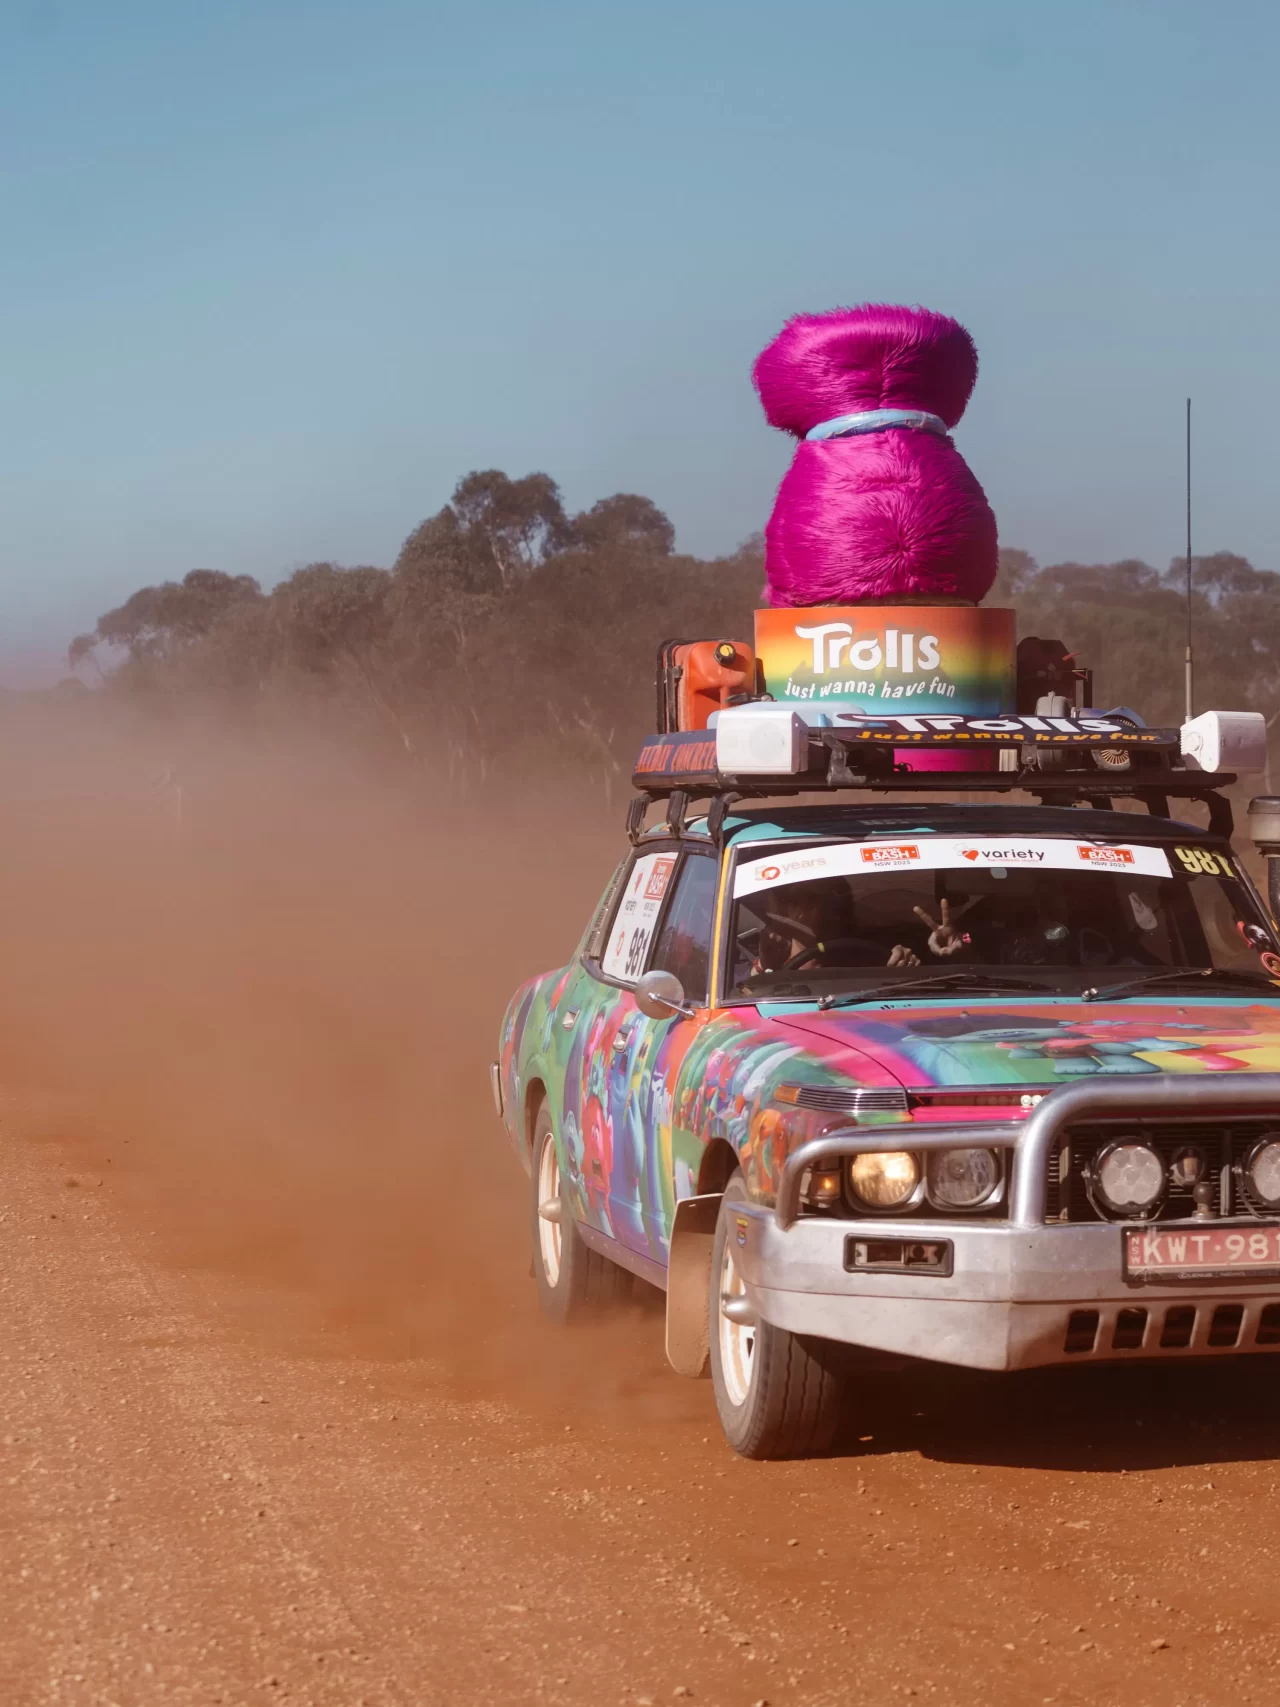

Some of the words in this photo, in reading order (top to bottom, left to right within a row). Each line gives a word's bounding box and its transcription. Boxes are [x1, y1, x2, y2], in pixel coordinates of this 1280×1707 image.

[795, 622, 941, 674] Trolls
[784, 677, 816, 699] just
[819, 680, 876, 698] wanna
[880, 681, 926, 699] have
[929, 676, 956, 698] fun
[851, 714, 1122, 733] Trolls
[933, 732, 1025, 741] wanna
[1035, 733, 1102, 741] have
[1109, 732, 1158, 741] fun
[872, 850, 910, 860] BASH
[981, 849, 1045, 861] variety
[1088, 851, 1125, 861] BASH
[1174, 847, 1234, 877] 981
[782, 858, 827, 874] years
[625, 927, 650, 976] 981
[1131, 1237, 1140, 1264] NSW
